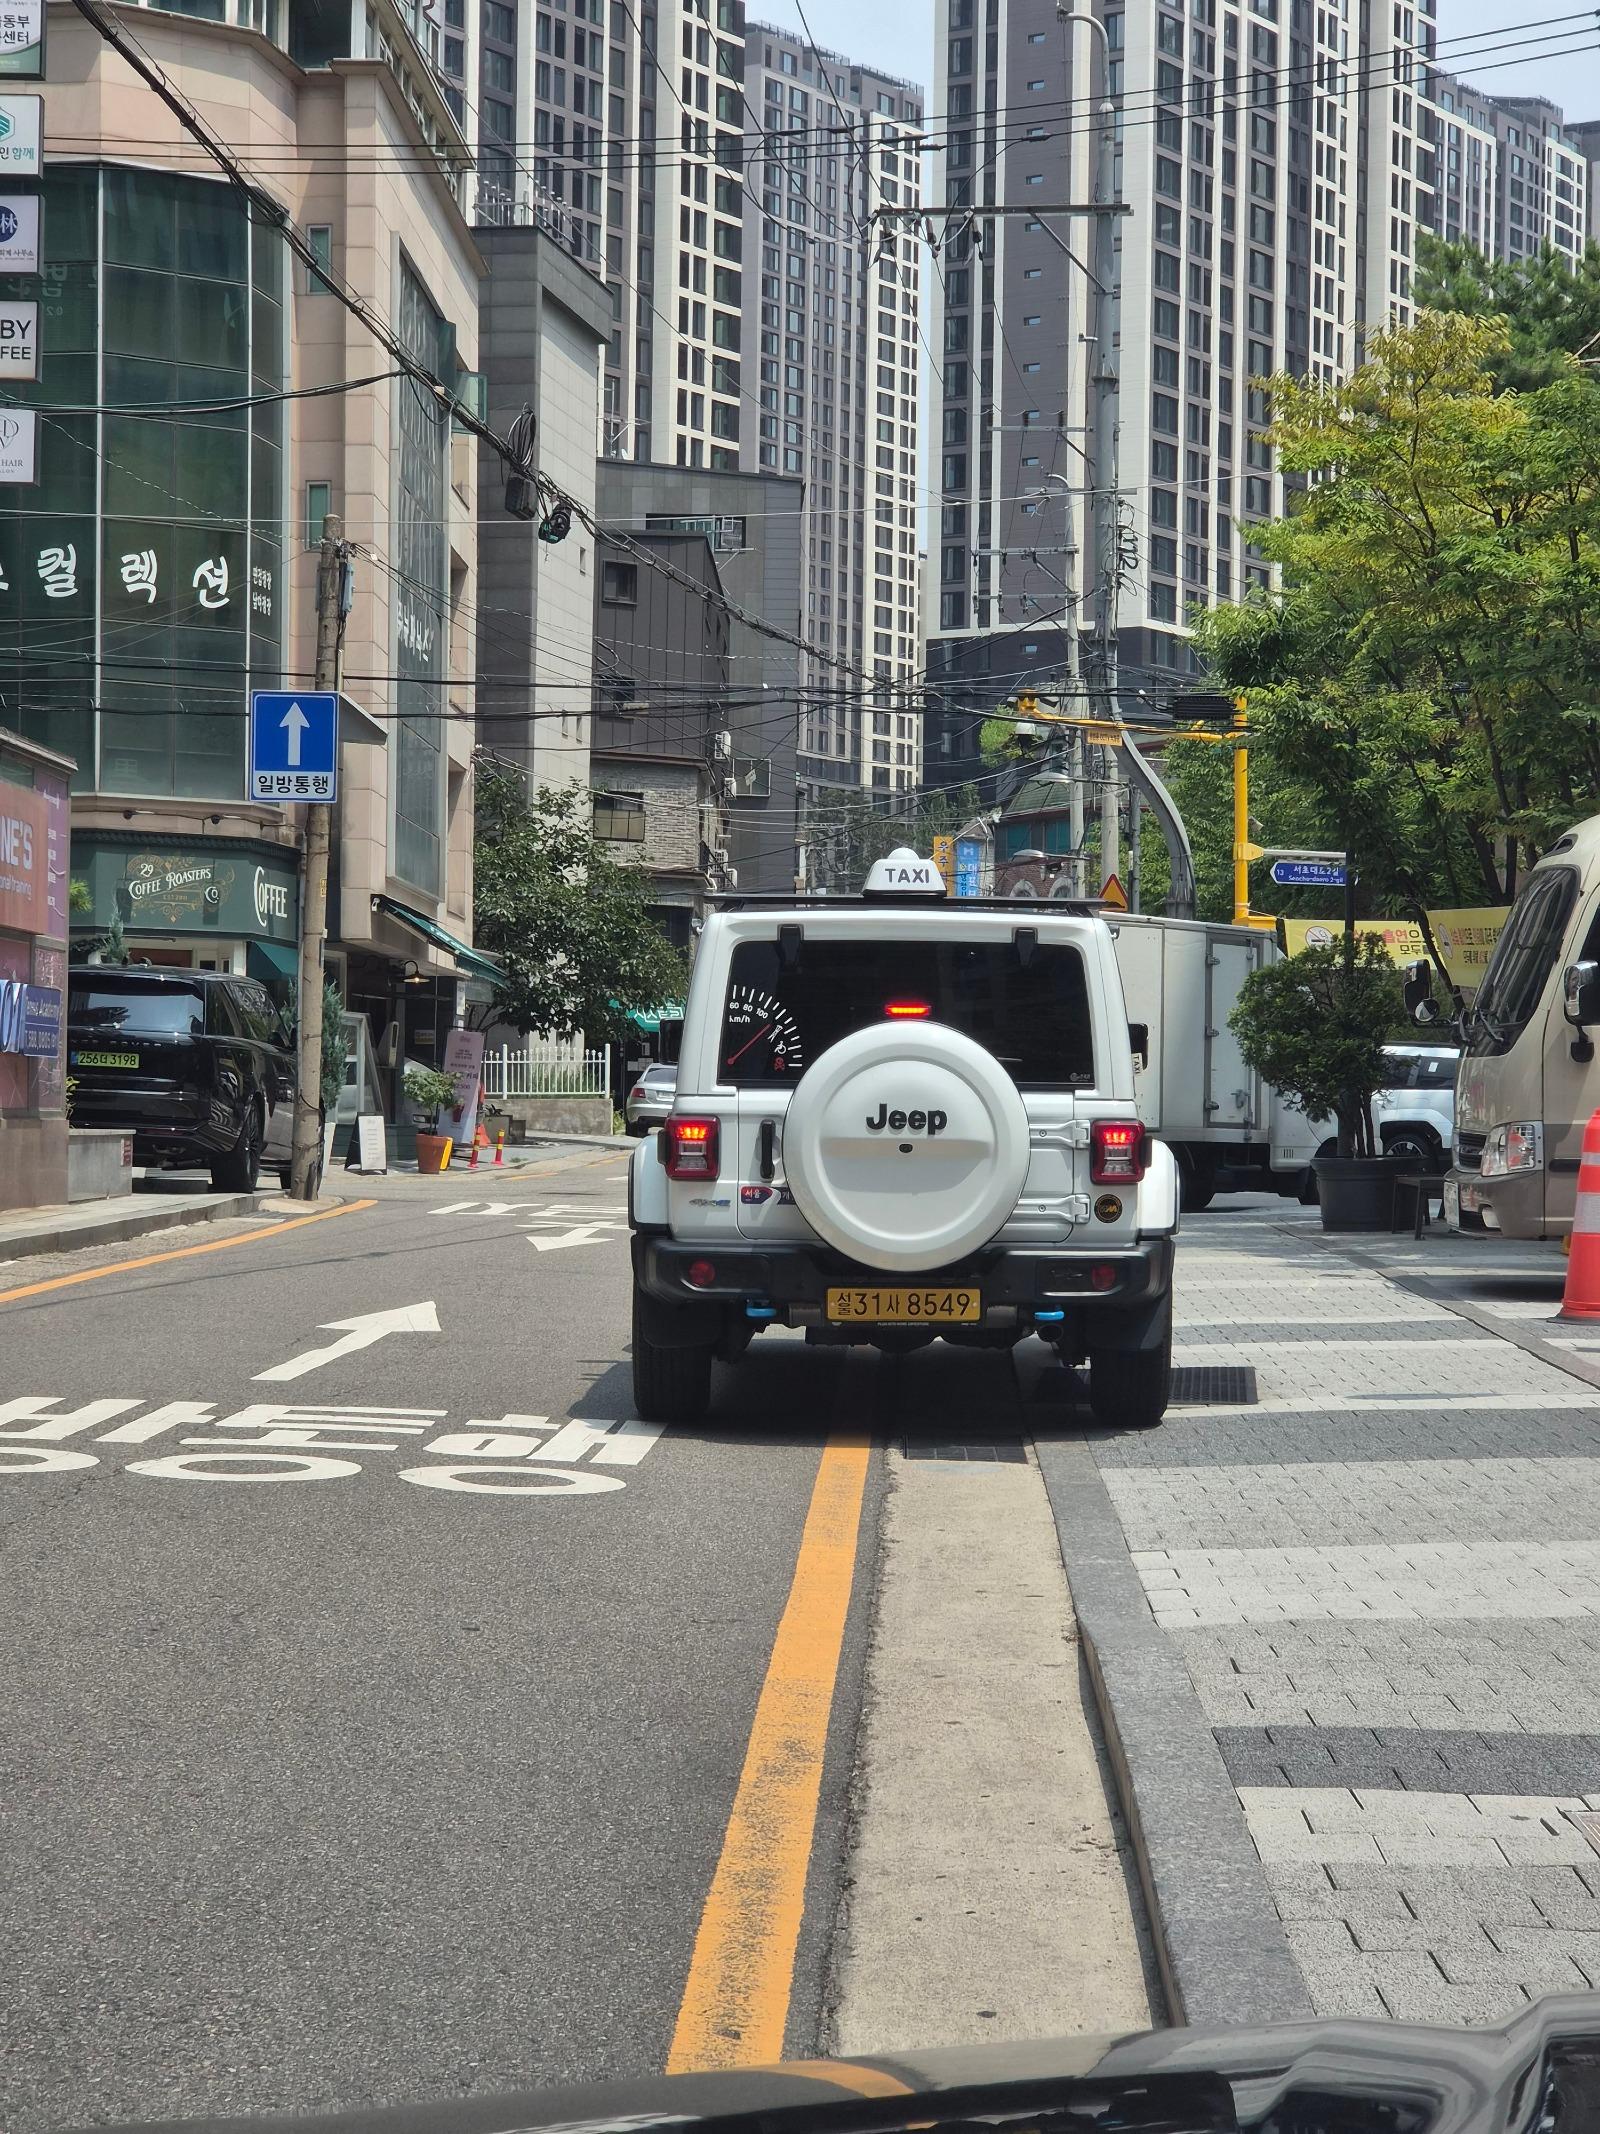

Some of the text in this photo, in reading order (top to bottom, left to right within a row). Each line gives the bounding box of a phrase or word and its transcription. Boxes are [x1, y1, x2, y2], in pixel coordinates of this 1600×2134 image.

[0, 14, 30, 28] 동부
[0, 31, 29, 44] 센터
[12, 147, 35, 160] 함께
[258, 775, 329, 794] 일방통행
[140, 863, 154, 878] 29
[885, 868, 929, 883] TAXI
[1293, 865, 1339, 877] 서초대로2길
[128, 868, 212, 900] COFFEE ROASTERS
[254, 865, 288, 927] COFFEE
[729, 1001, 769, 1019] 60 80 100
[729, 1015, 751, 1023] km/h
[866, 1103, 948, 1135] Jeep
[745, 1188, 761, 1199] 서울
